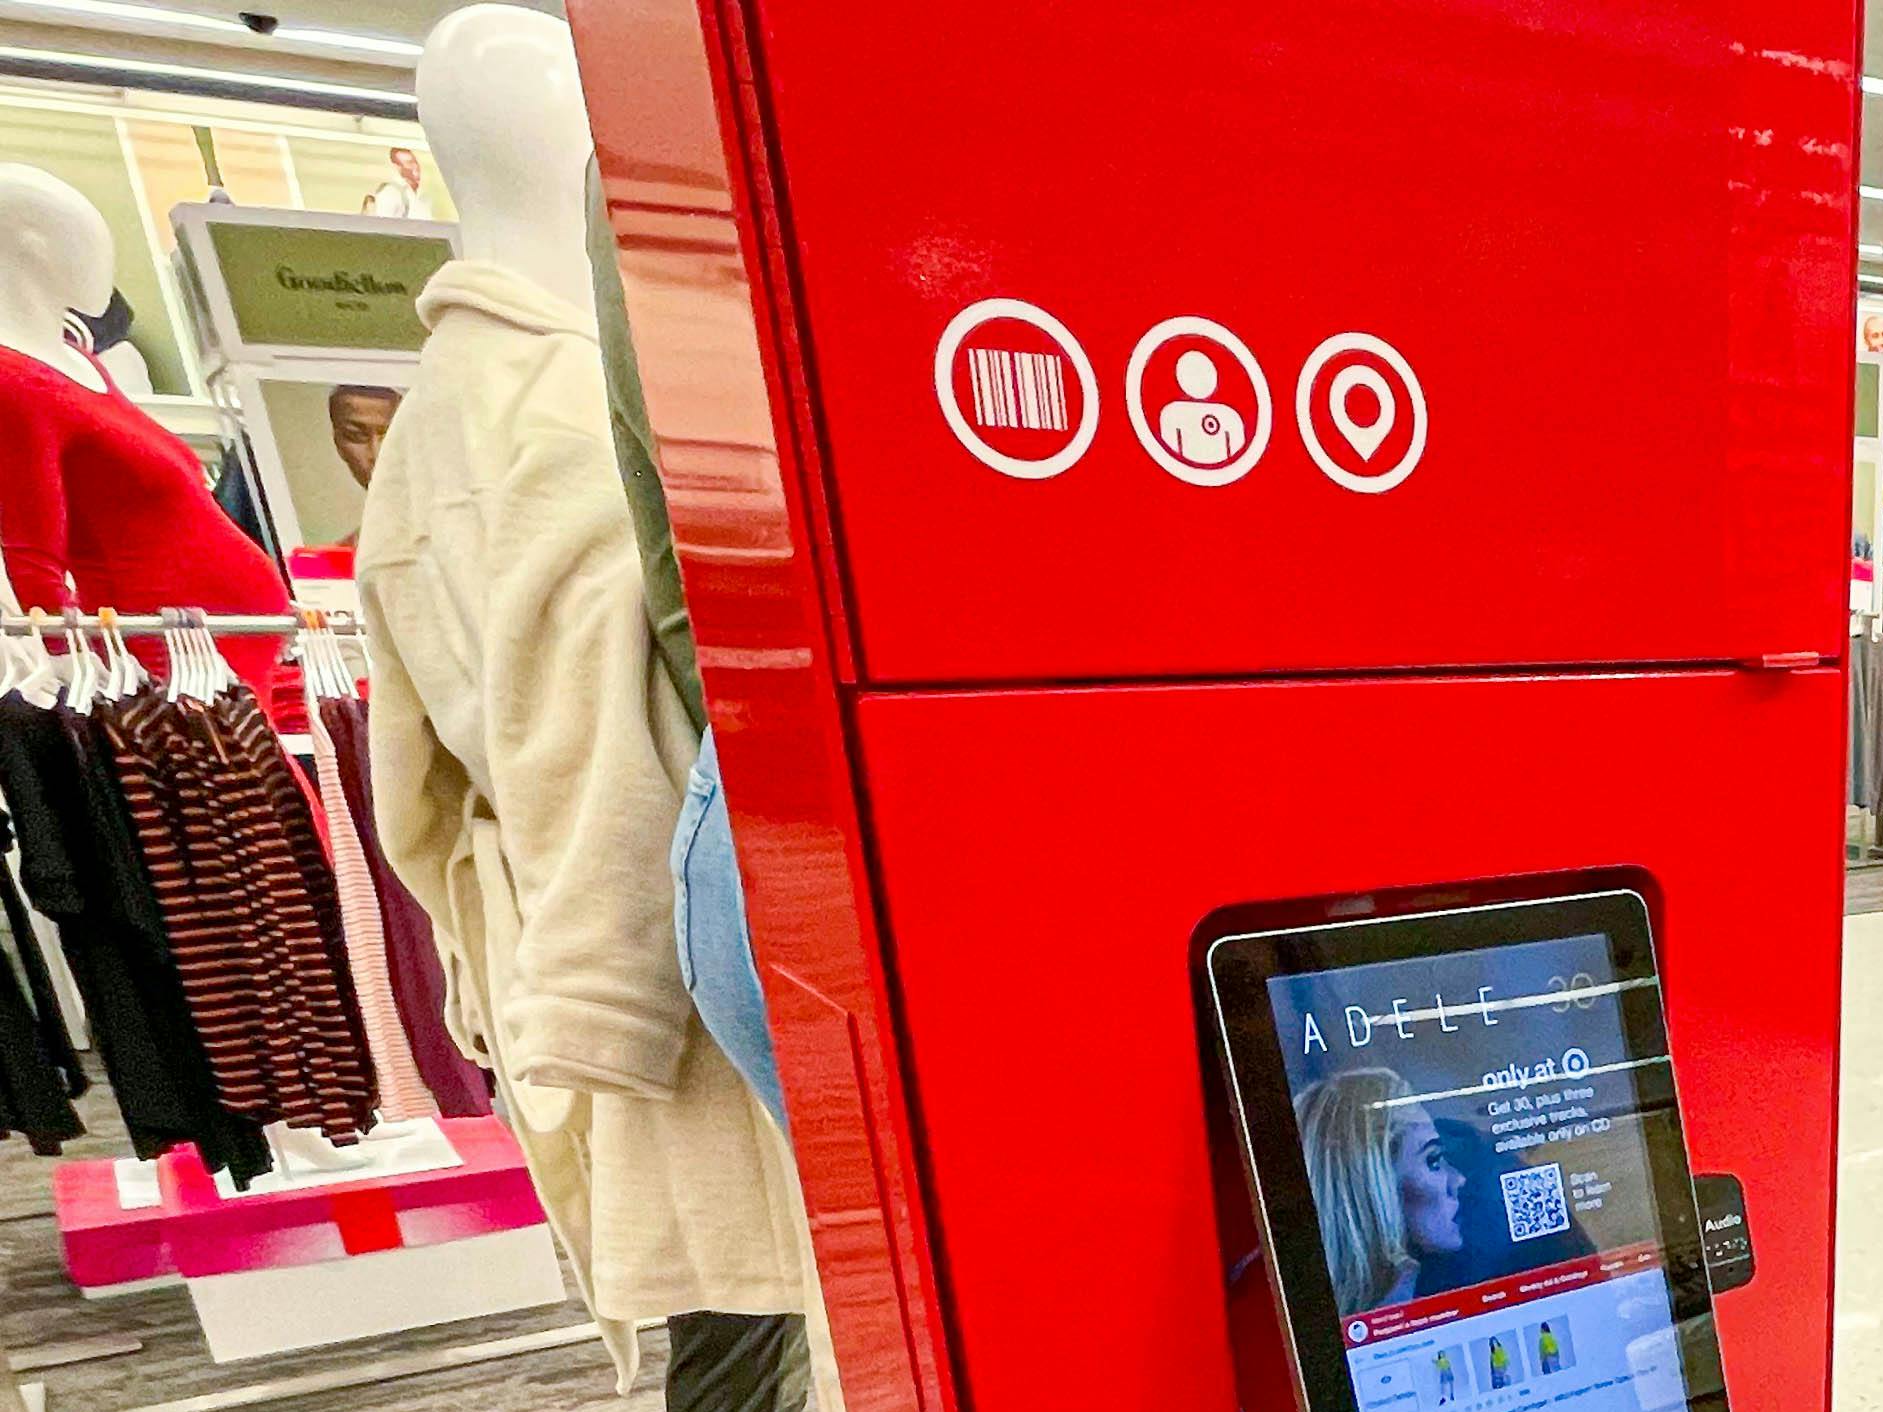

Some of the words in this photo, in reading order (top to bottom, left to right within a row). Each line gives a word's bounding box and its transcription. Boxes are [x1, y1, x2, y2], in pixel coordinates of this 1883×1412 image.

[1303, 986, 1499, 1055] ADELE
[1548, 973, 1596, 1014] 30
[1481, 1063, 1529, 1090] only
[1534, 1058, 1556, 1081] at
[1487, 1100, 1511, 1116] Get
[1536, 1092, 1562, 1109] plus
[1563, 1086, 1594, 1101] three
[1491, 1114, 1548, 1135] exclusive
[1548, 1127, 1572, 1142] only
[1574, 1124, 1591, 1137] on
[1590, 1117, 1611, 1133] CD
[1705, 1213, 1742, 1233] Audio
